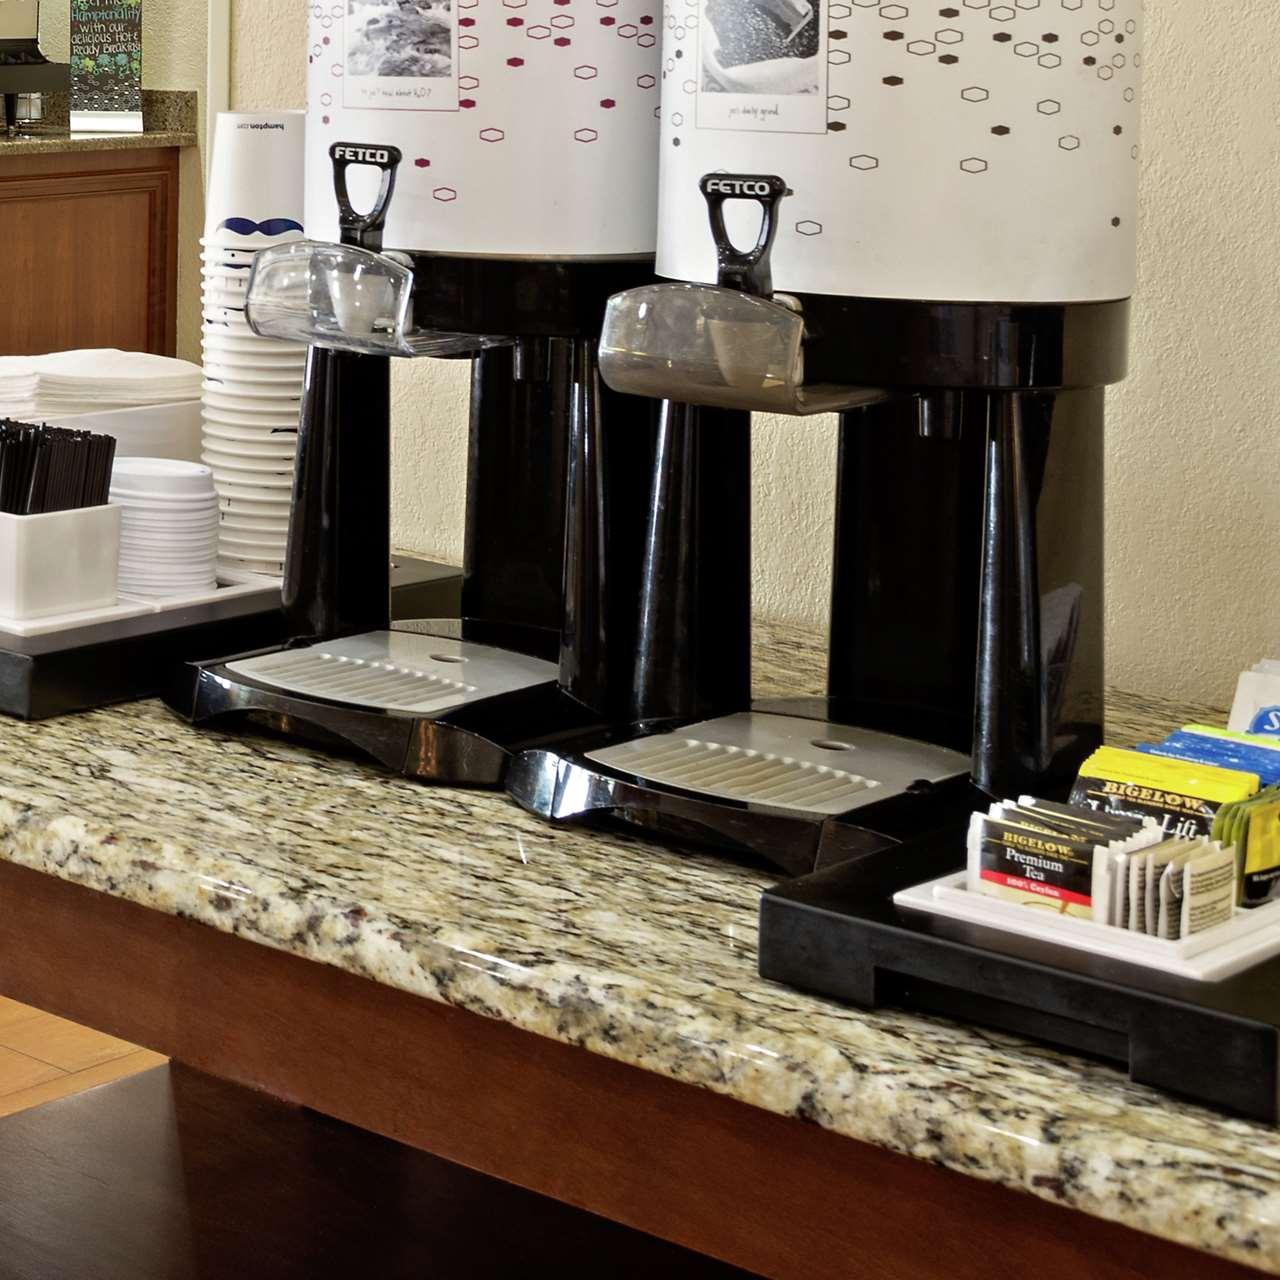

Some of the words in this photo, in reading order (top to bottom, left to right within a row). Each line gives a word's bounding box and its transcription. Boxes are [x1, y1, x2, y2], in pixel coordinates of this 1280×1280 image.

[79, 20, 106, 33] with
[109, 23, 128, 32] our
[71, 32, 111, 44] delicious
[73, 44, 100, 56] Ready
[335, 146, 389, 163] FETCO
[706, 179, 770, 195] FETCO
[1102, 780, 1207, 814] BIGELOW
[1162, 813, 1198, 839] Lift
[1003, 831, 1072, 856] BIGELOW
[1006, 847, 1064, 872] Premium
[1022, 865, 1045, 880] Tea
